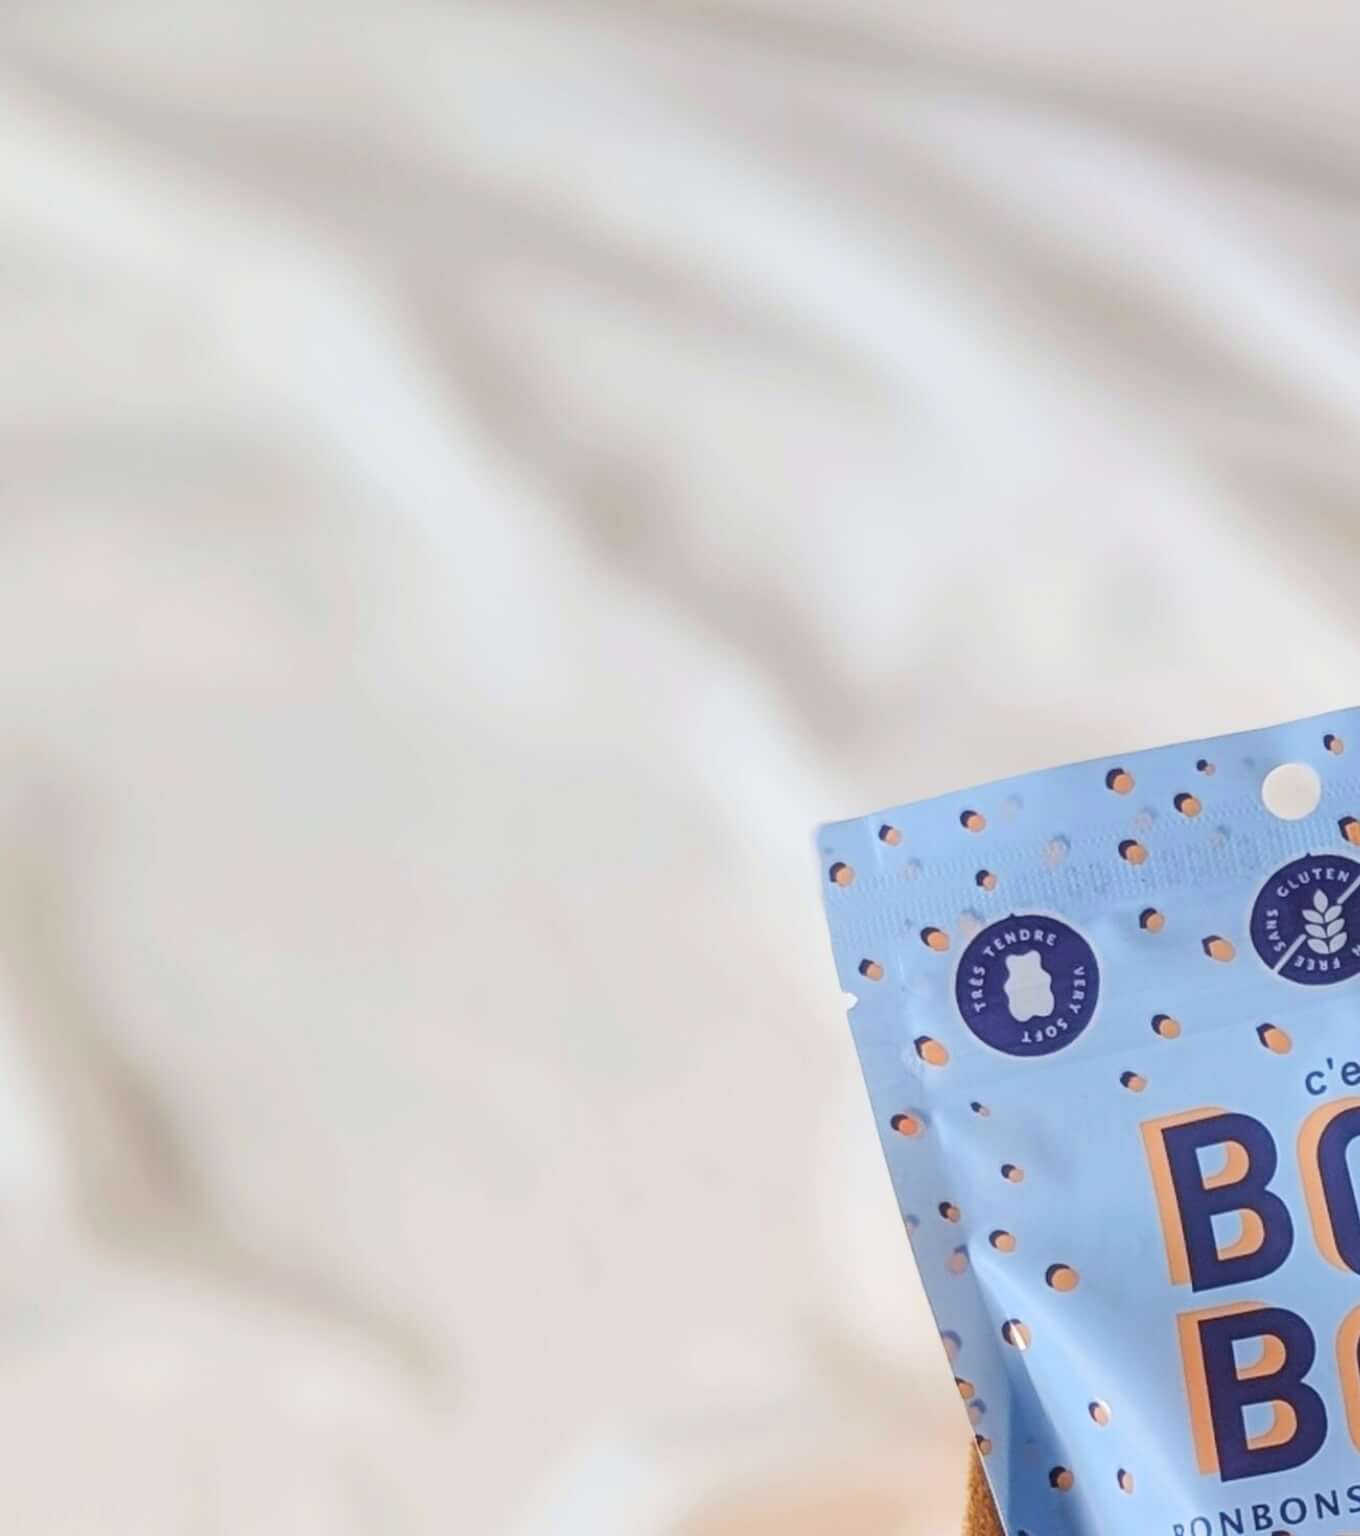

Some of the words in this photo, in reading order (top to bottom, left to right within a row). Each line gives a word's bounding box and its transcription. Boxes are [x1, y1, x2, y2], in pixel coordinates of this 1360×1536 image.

[1266, 909, 1286, 952] SANS
[1277, 868, 1349, 898] GLUTEN
[983, 929, 1057, 958] TENDRE
[1294, 955, 1342, 971] FREE
[1069, 966, 1087, 1014] VERY
[1021, 1018, 1068, 1043] SOFT
